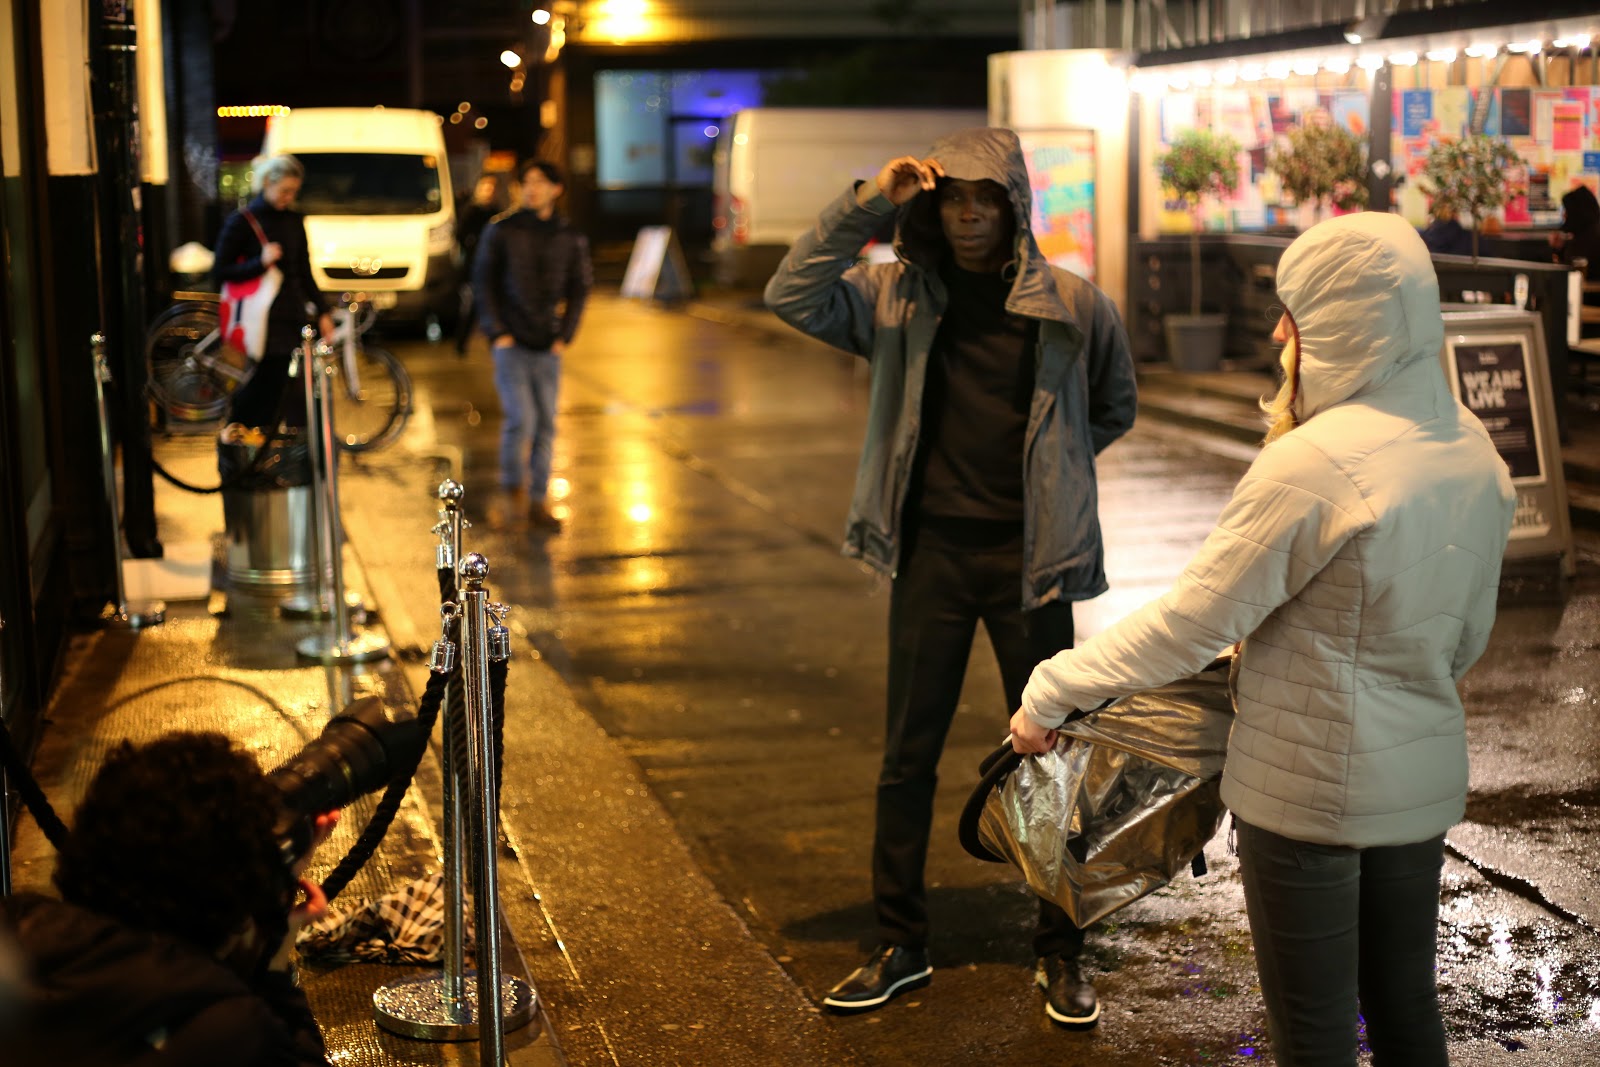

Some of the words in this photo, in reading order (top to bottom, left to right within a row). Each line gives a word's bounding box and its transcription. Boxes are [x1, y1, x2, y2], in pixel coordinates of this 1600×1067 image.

[1462, 371, 1490, 391] WE
[1491, 370, 1522, 390] ARE
[1467, 389, 1506, 409] LIVE
